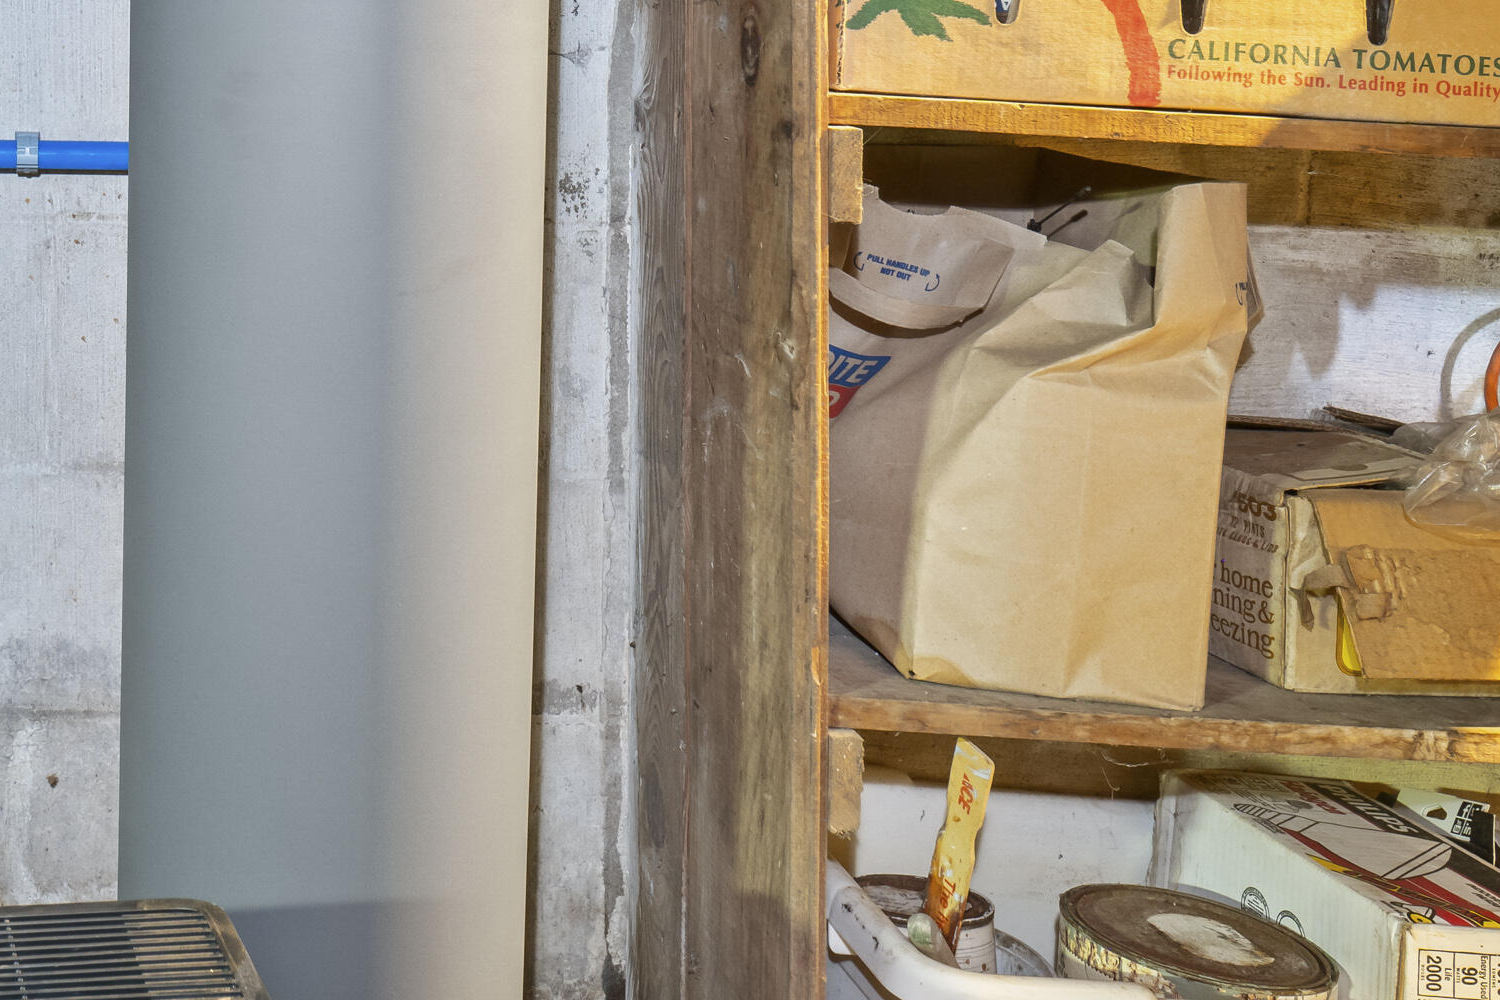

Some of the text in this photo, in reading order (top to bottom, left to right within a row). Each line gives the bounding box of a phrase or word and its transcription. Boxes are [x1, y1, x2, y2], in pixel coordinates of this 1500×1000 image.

[1168, 38, 1341, 68] CALIFORNIA
[1167, 66, 1500, 102] Following the Sun. Leading in Quality
[867, 254, 930, 276] PULL HANDLES UP
[880, 267, 911, 281] NOT OUT
[1220, 561, 1273, 598] home
[1259, 601, 1274, 624] &
[1317, 784, 1420, 833] PHILIPS
[1426, 955, 1442, 991] 2000
[1462, 967, 1478, 985] 90
[1479, 956, 1488, 1000] Energy Used
